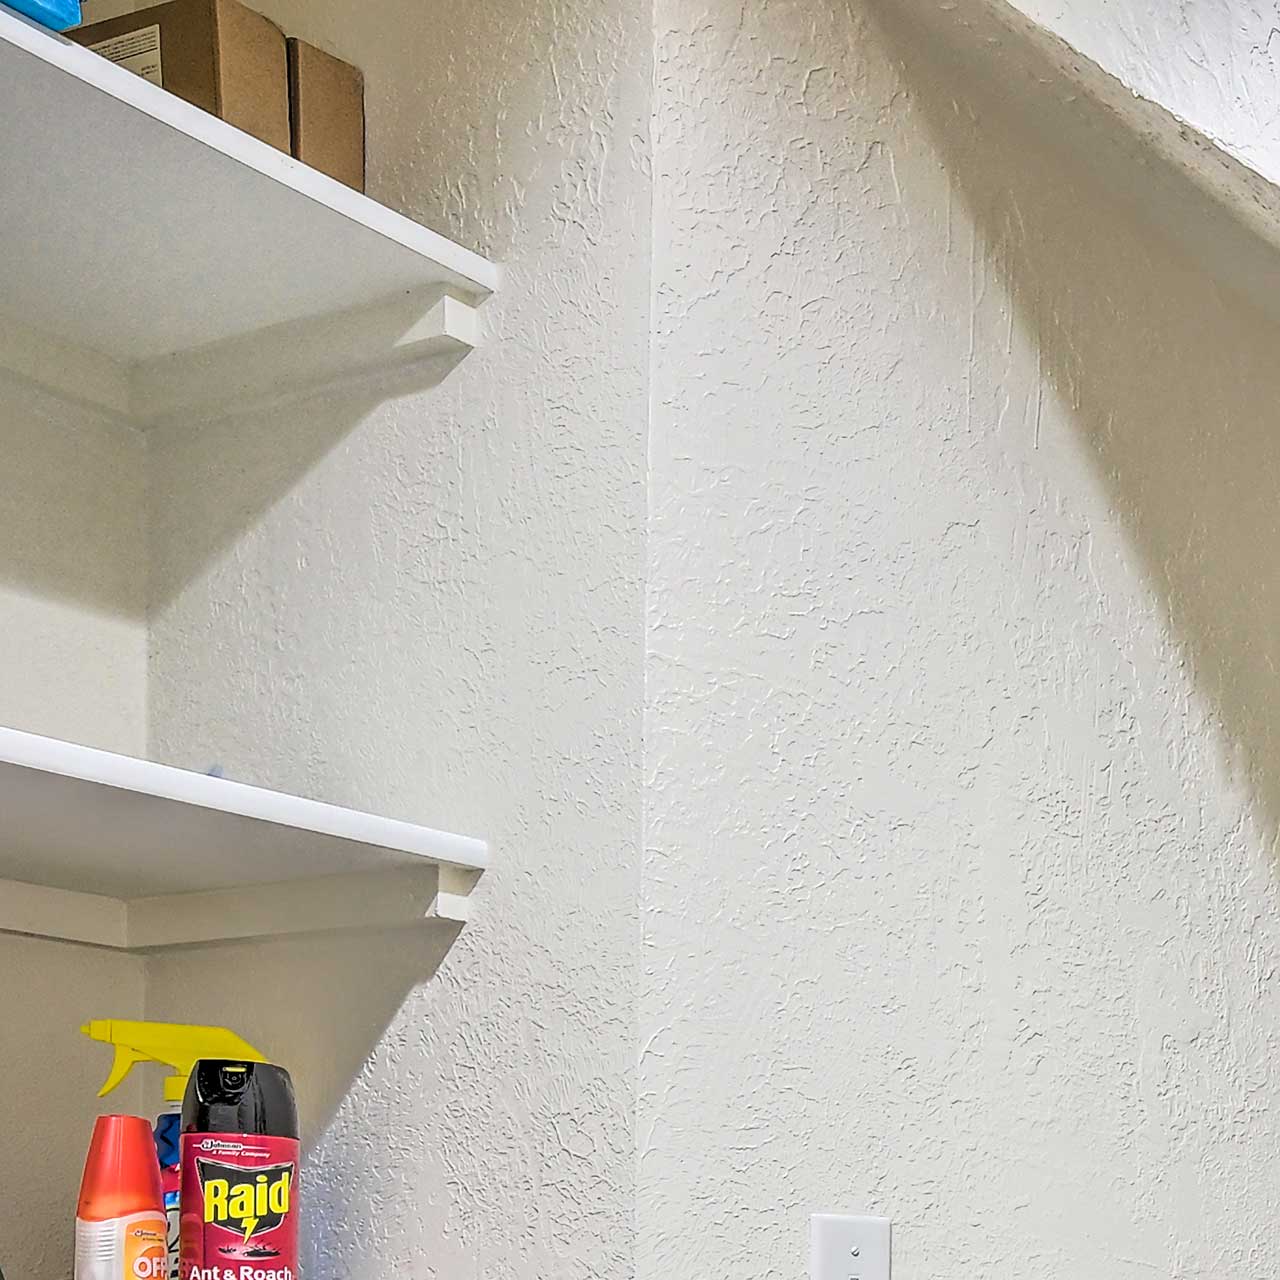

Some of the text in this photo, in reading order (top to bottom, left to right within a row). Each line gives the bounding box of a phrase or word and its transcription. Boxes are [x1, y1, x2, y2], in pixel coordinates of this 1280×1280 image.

[204, 1171, 290, 1223] Raid
[190, 1266, 221, 1280] Ant
[223, 1268, 236, 1280] &
